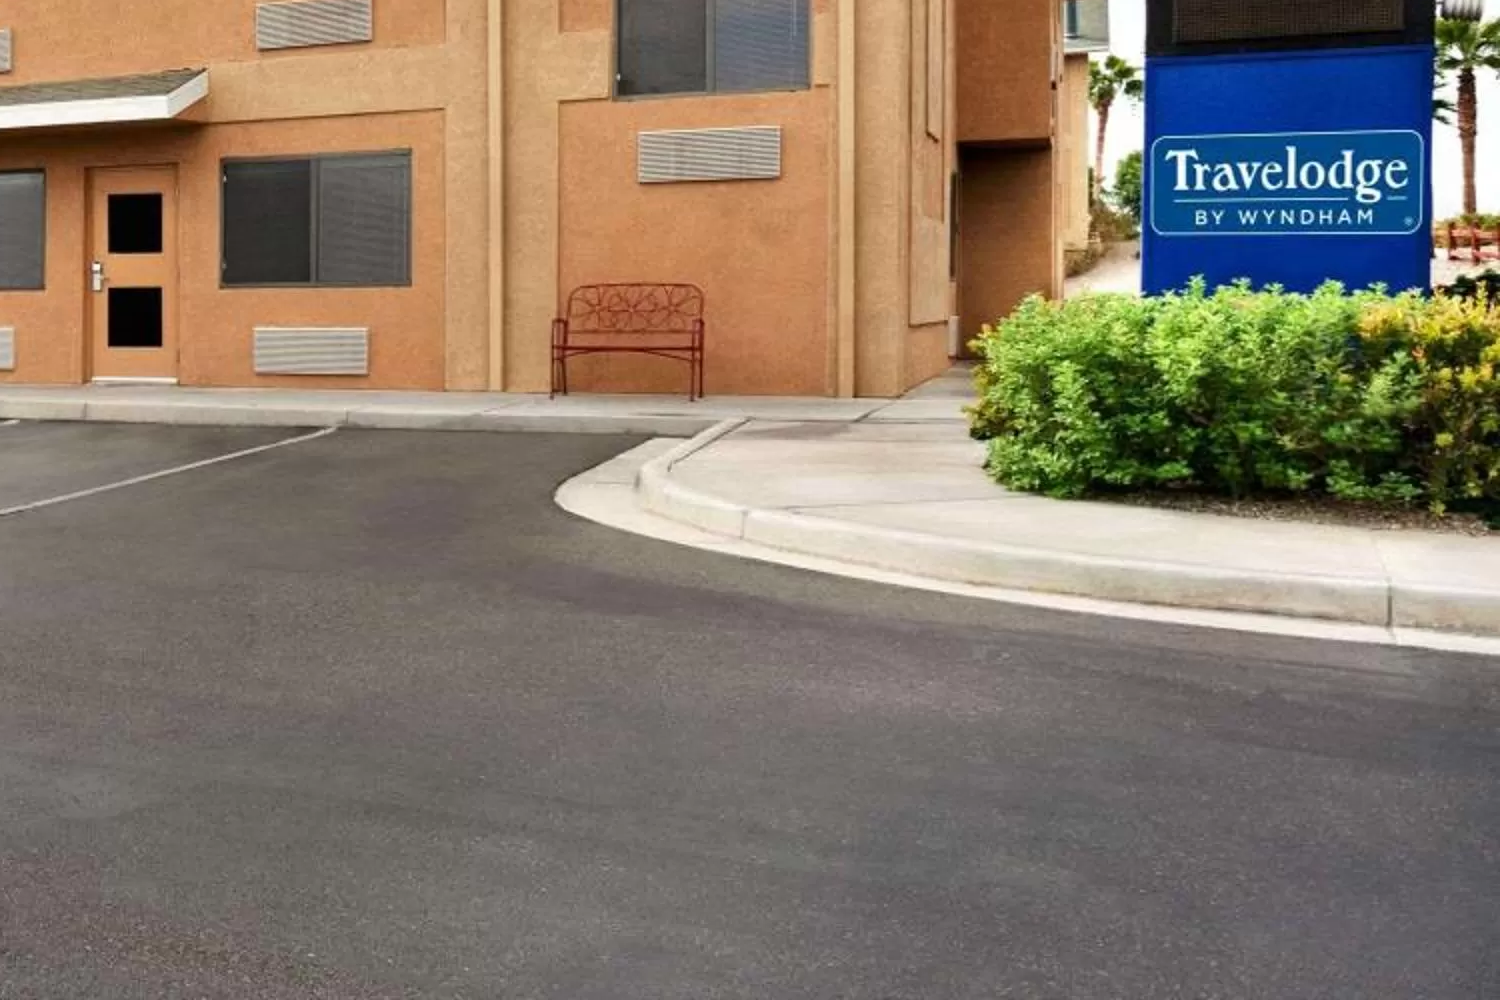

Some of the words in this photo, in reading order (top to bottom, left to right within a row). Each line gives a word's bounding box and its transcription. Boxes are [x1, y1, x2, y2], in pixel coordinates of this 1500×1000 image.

[1165, 146, 1408, 204] Travelodge
[1194, 209, 1225, 225] BY
[1238, 208, 1374, 225] WYNDHAM
